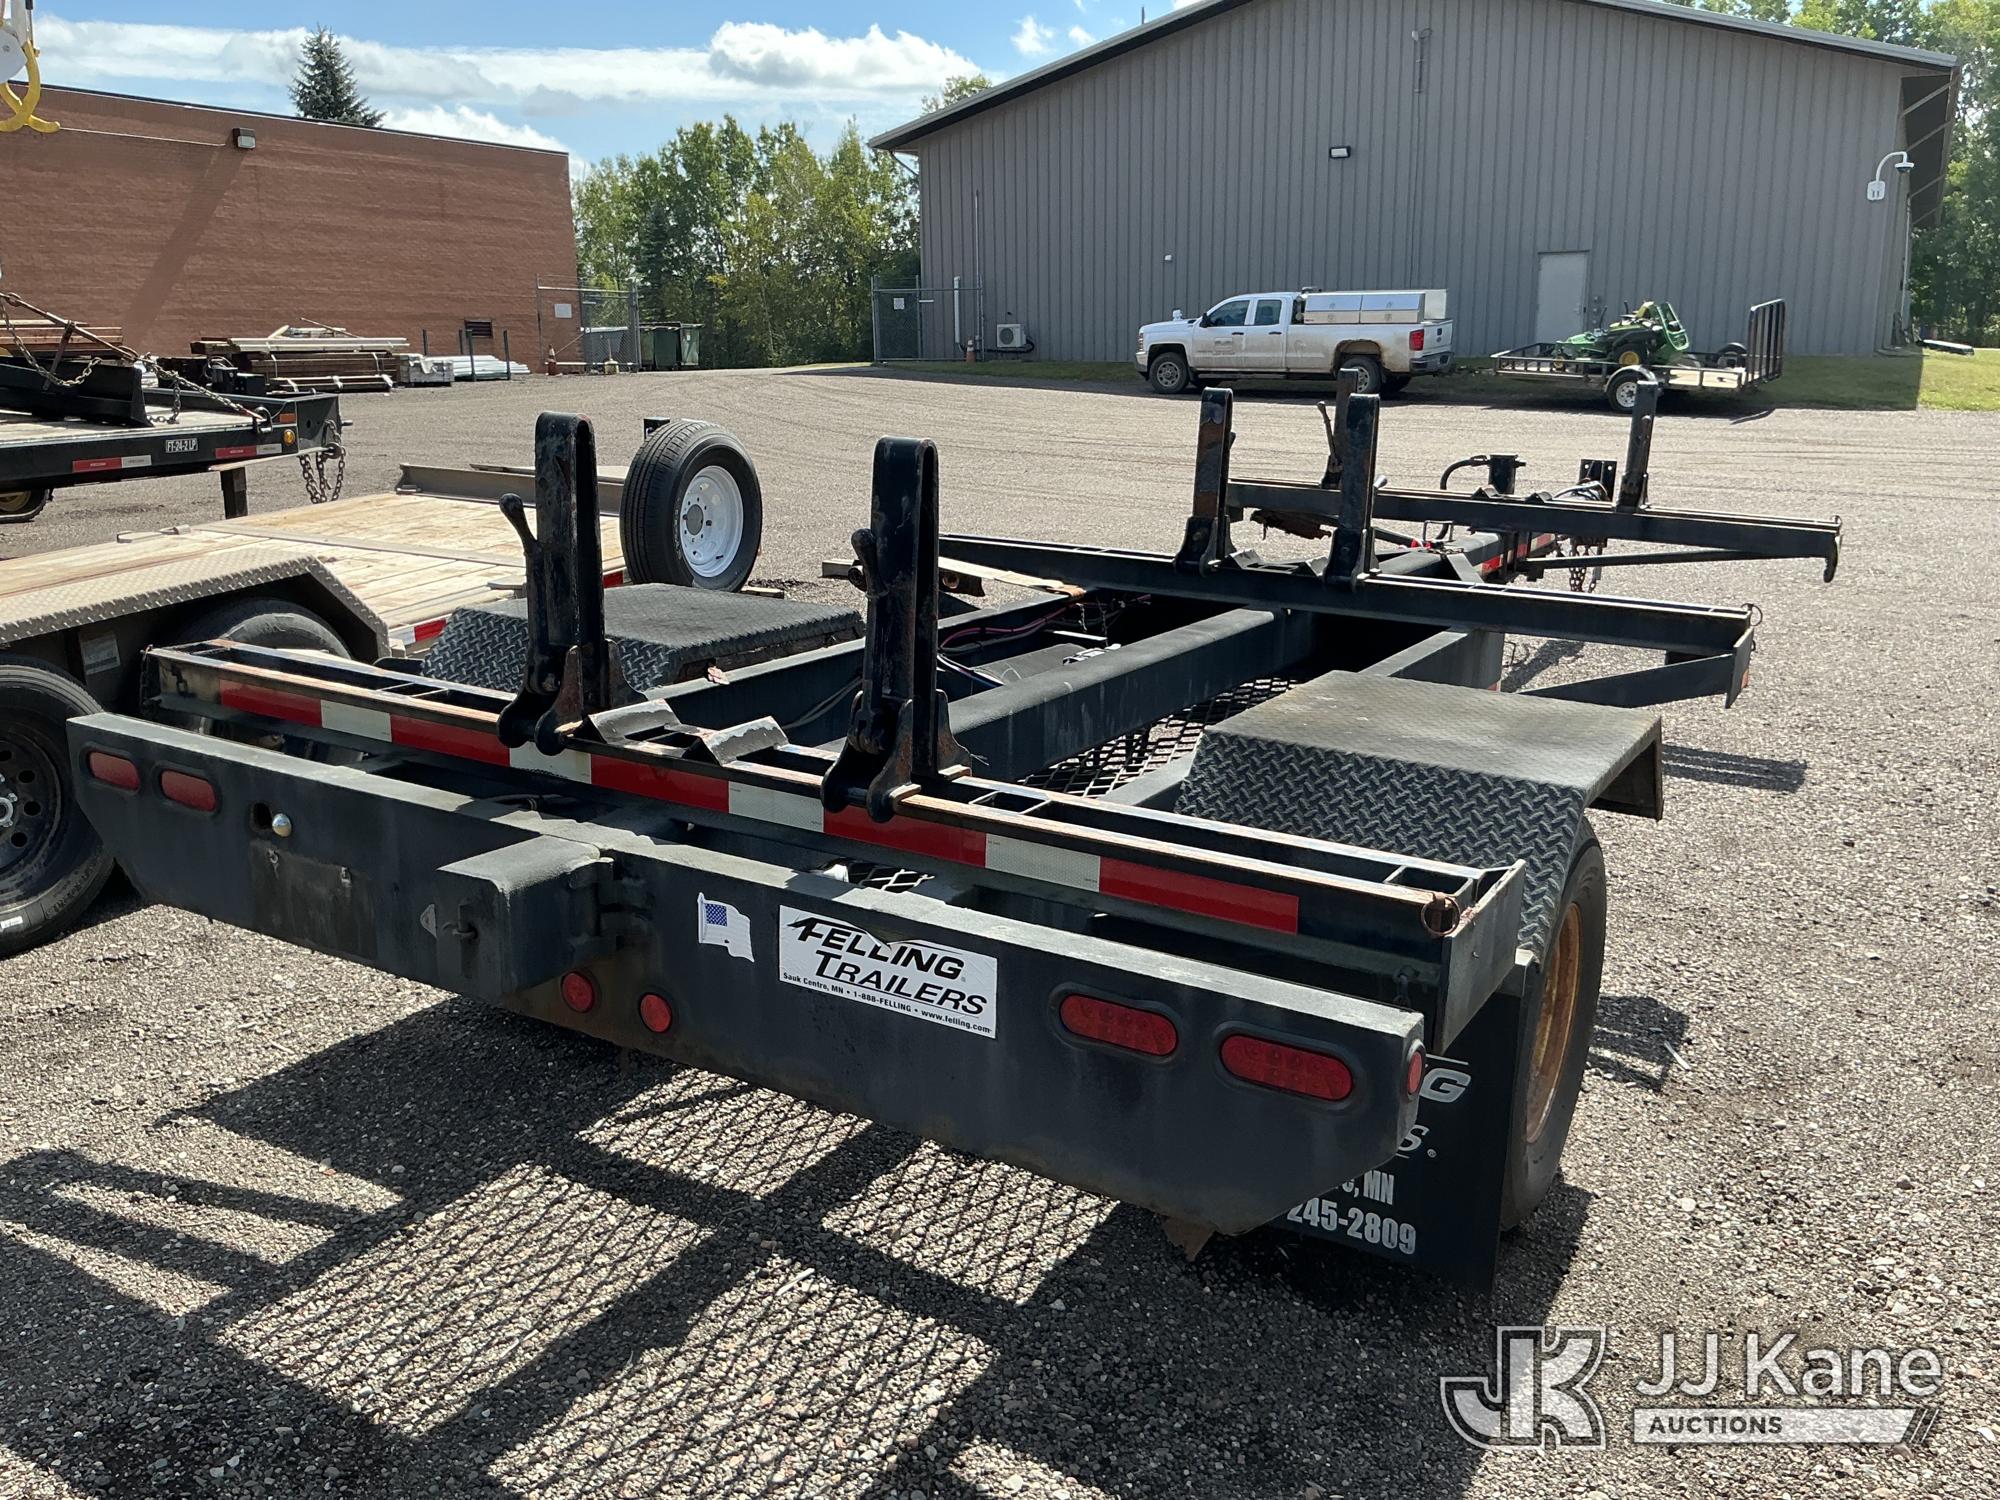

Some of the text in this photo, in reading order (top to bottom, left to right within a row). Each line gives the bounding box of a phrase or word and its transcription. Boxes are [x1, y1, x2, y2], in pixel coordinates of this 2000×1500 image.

[787, 917, 965, 981] FELLING
[783, 972, 802, 983] Sauk
[831, 984, 844, 994] MN
[853, 991, 912, 1012] 1-888-FELLING
[921, 1009, 991, 1034] www.felling.com
[815, 950, 988, 1015] TRAILERS
[1363, 1169, 1395, 1205] MN
